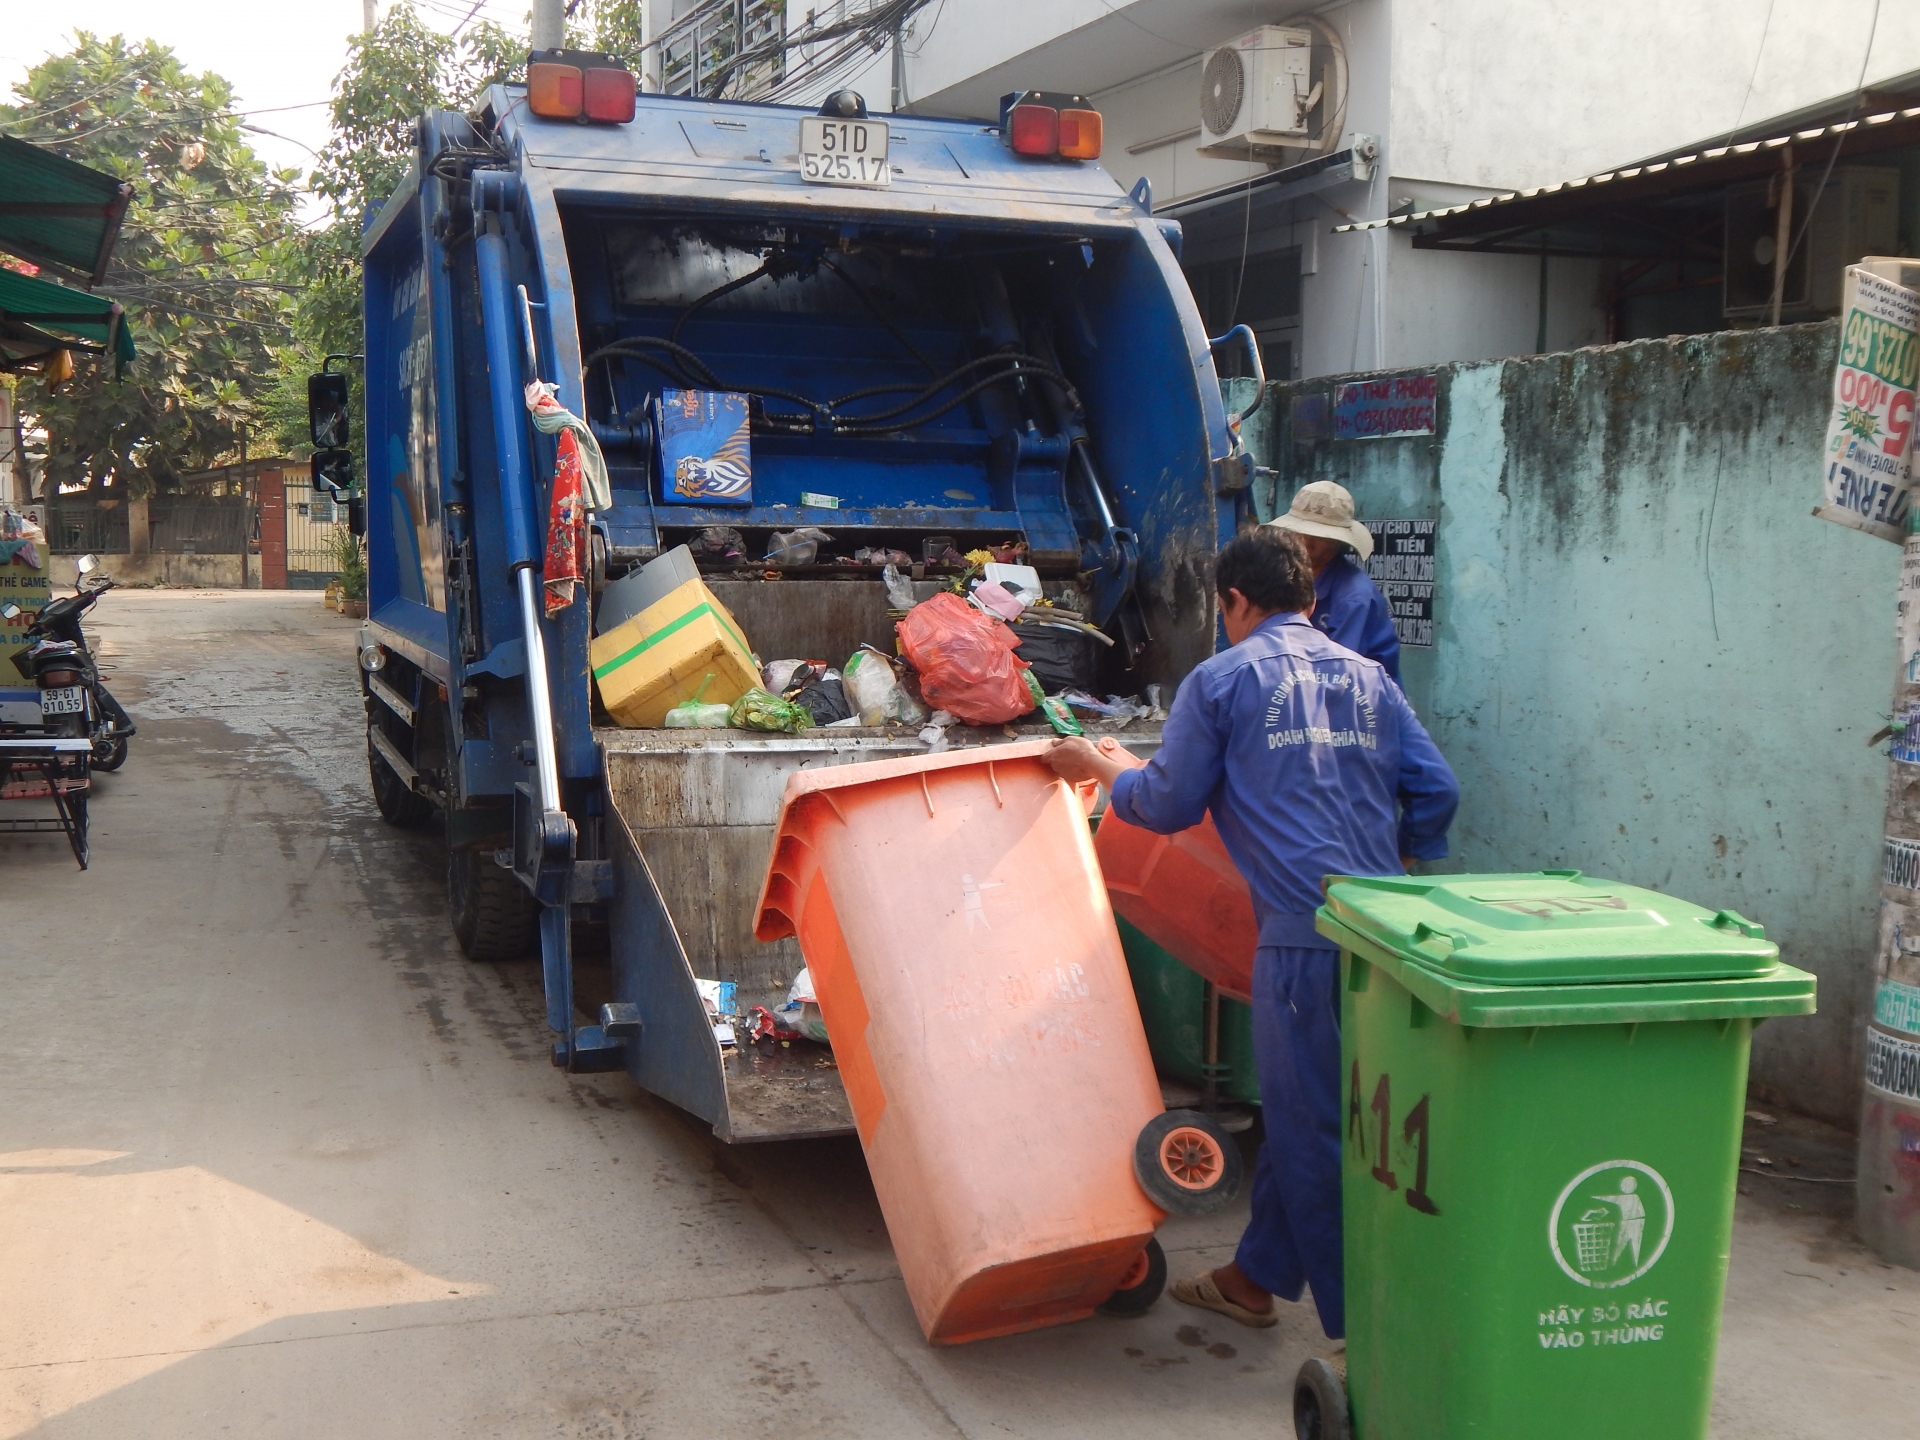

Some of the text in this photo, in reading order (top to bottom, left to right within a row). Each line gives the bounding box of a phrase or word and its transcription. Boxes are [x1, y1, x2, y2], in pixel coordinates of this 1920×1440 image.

[822, 123, 867, 153] 51D
[804, 153, 884, 181] 525.17
[1387, 521, 1435, 534] CHO VAY
[20, 577, 47, 588] GAME
[1387, 584, 1409, 597] CHO
[1412, 585, 1433, 598] VAY
[1332, 672, 1352, 689] RÁC
[46, 688, 75, 701] 59-G1
[1271, 681, 1291, 706] GOM
[43, 700, 80, 713] 910.55
[1265, 706, 1281, 728] THU
[1268, 728, 1305, 750] DOANH
[1331, 728, 1357, 748] GHĨA
[1349, 1057, 1441, 1216] A11
[1539, 1304, 1586, 1326] HÃY
[1627, 1297, 1669, 1320] RÁC
[1539, 1323, 1664, 1349] VÀO THÙNG
